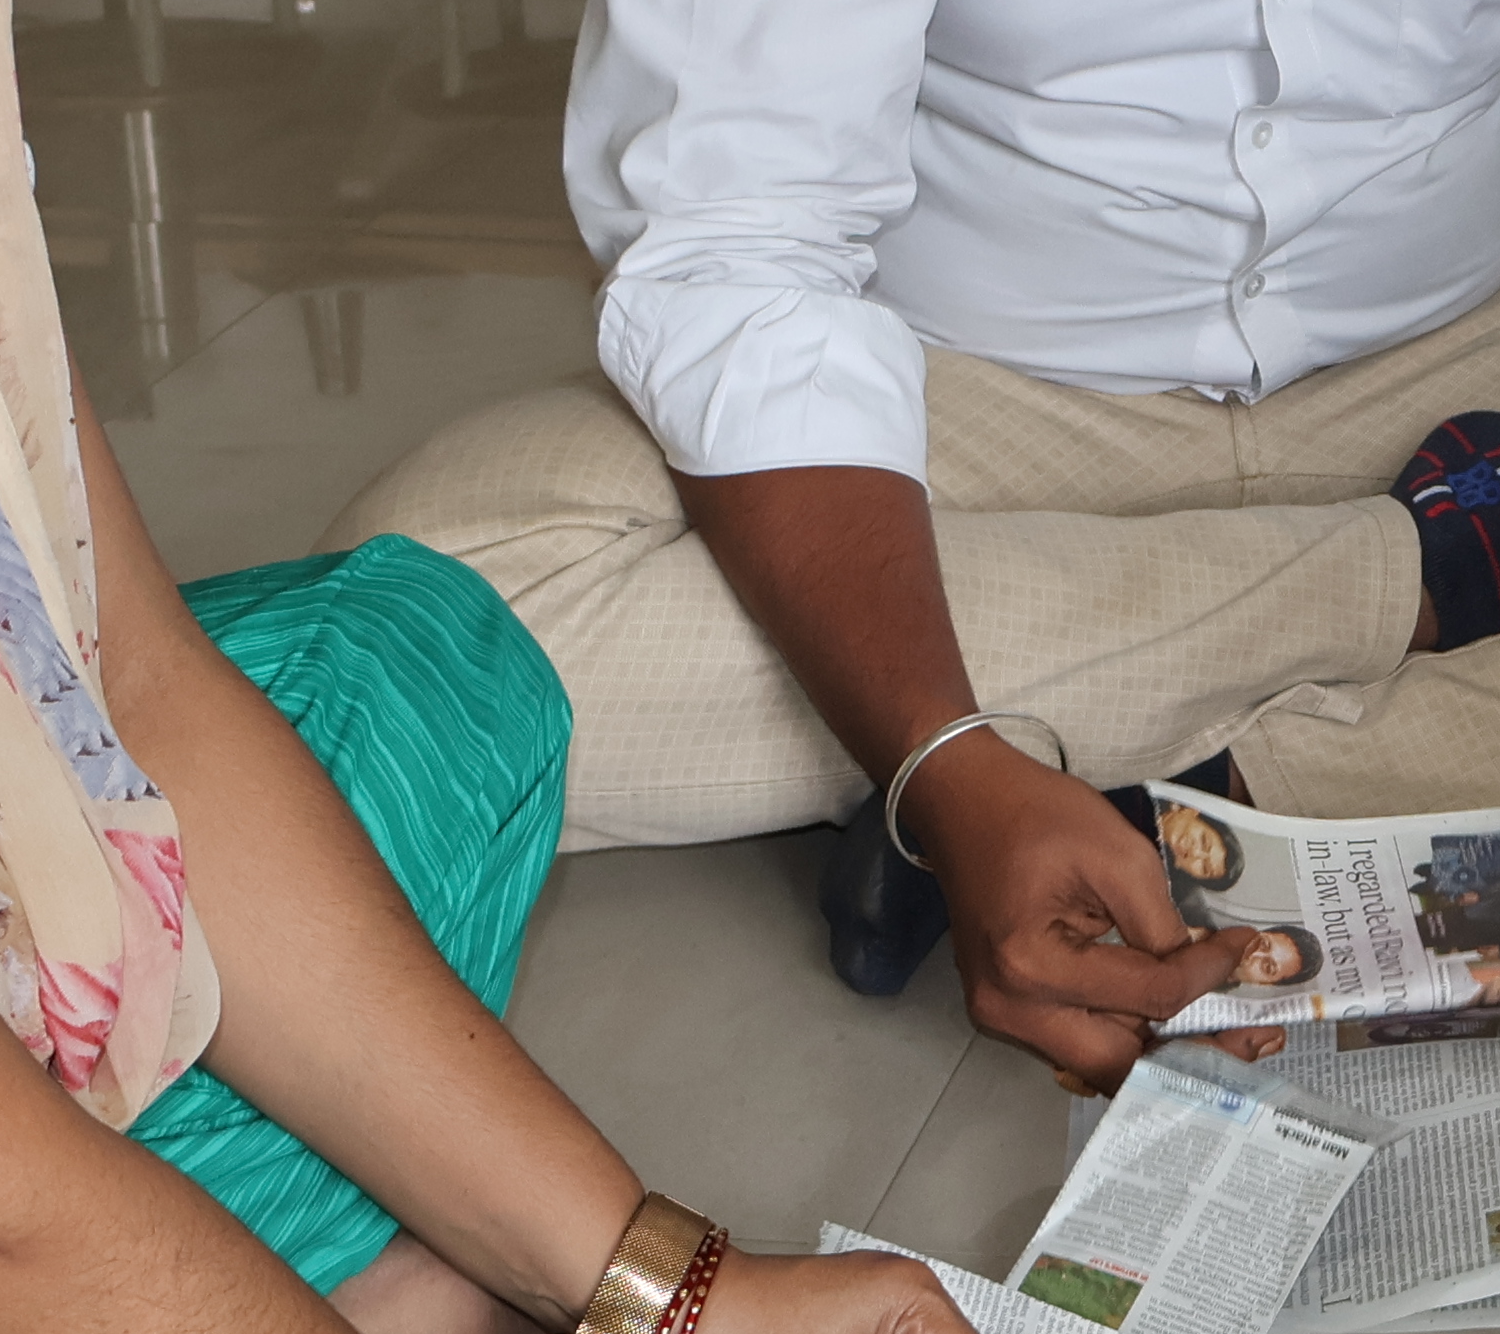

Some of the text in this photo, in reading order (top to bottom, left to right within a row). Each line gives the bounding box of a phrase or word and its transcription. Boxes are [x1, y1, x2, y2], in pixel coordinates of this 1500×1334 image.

[1306, 837, 1347, 907] in-law,
[1345, 847, 1401, 940] regarded
[1322, 908, 1354, 943] but
[1328, 945, 1356, 966] as
[1272, 1123, 1350, 1162] Man attacks
